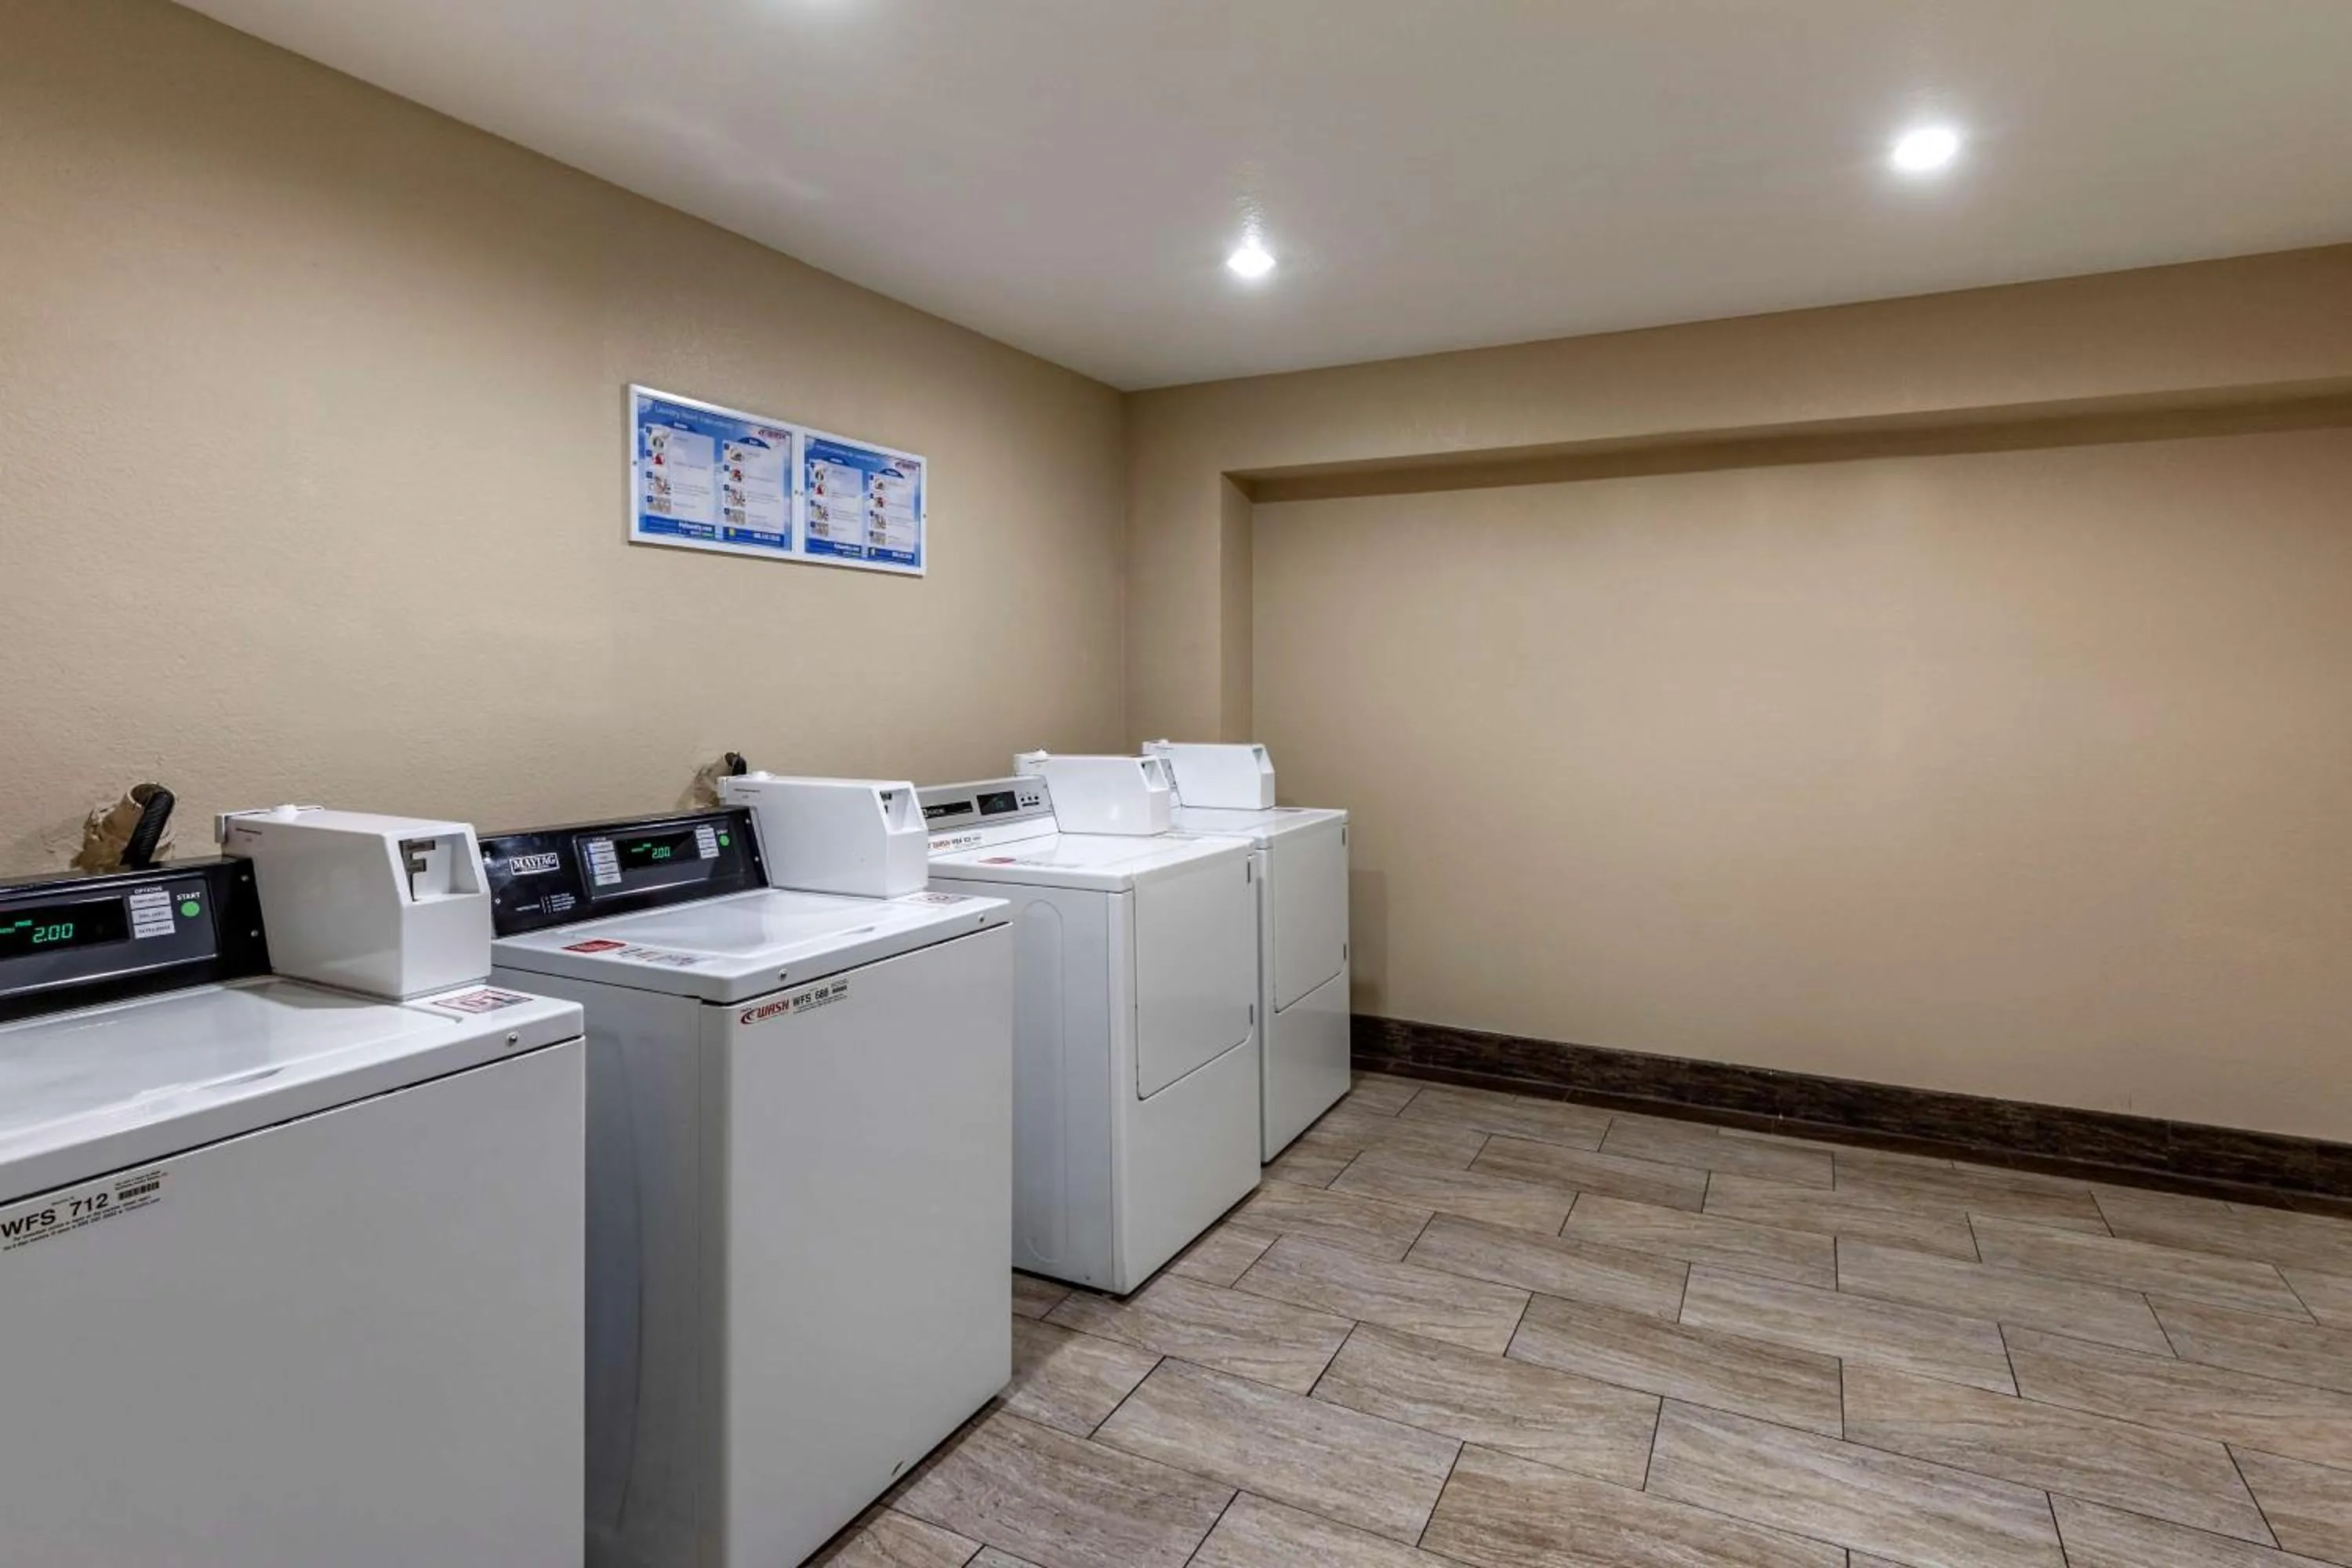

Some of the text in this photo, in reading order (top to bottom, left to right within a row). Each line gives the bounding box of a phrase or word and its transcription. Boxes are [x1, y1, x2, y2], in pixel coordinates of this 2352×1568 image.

[514, 855, 556, 869] MAYTAG
[176, 891, 201, 901] START
[34, 923, 73, 943] 2.00
[757, 1000, 789, 1018] WASH
[1, 1208, 56, 1237] WFS
[69, 1192, 108, 1216] 712
